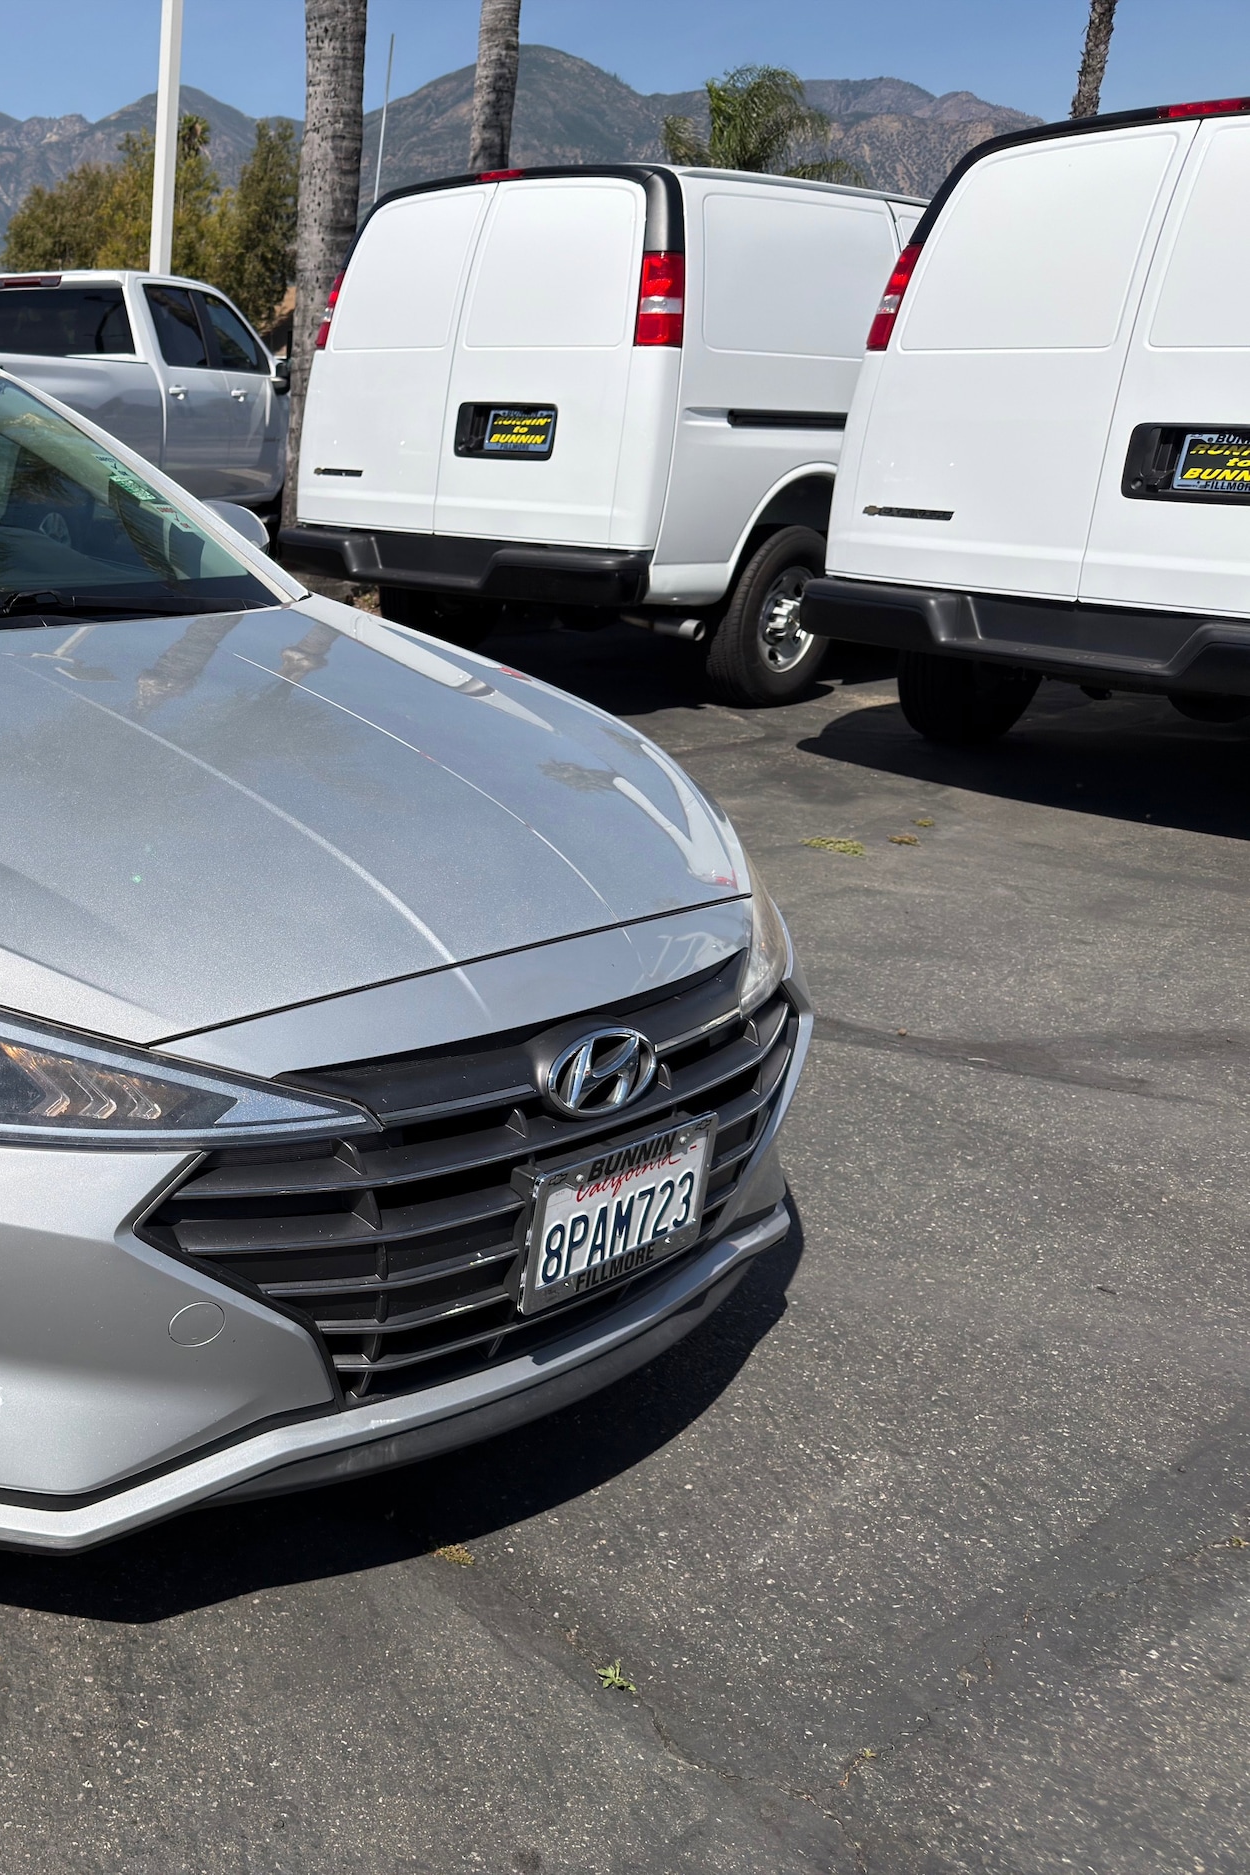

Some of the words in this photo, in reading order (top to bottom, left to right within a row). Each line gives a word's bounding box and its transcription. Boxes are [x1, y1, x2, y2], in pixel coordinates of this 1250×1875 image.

[490, 433, 546, 445] BUNNIN
[512, 426, 529, 434] to
[1226, 457, 1250, 467] to
[576, 1151, 681, 1203] California
[588, 1131, 678, 1182] BUNNIN
[541, 1170, 695, 1285] 8PAM723
[575, 1241, 655, 1293] FILLMORE
